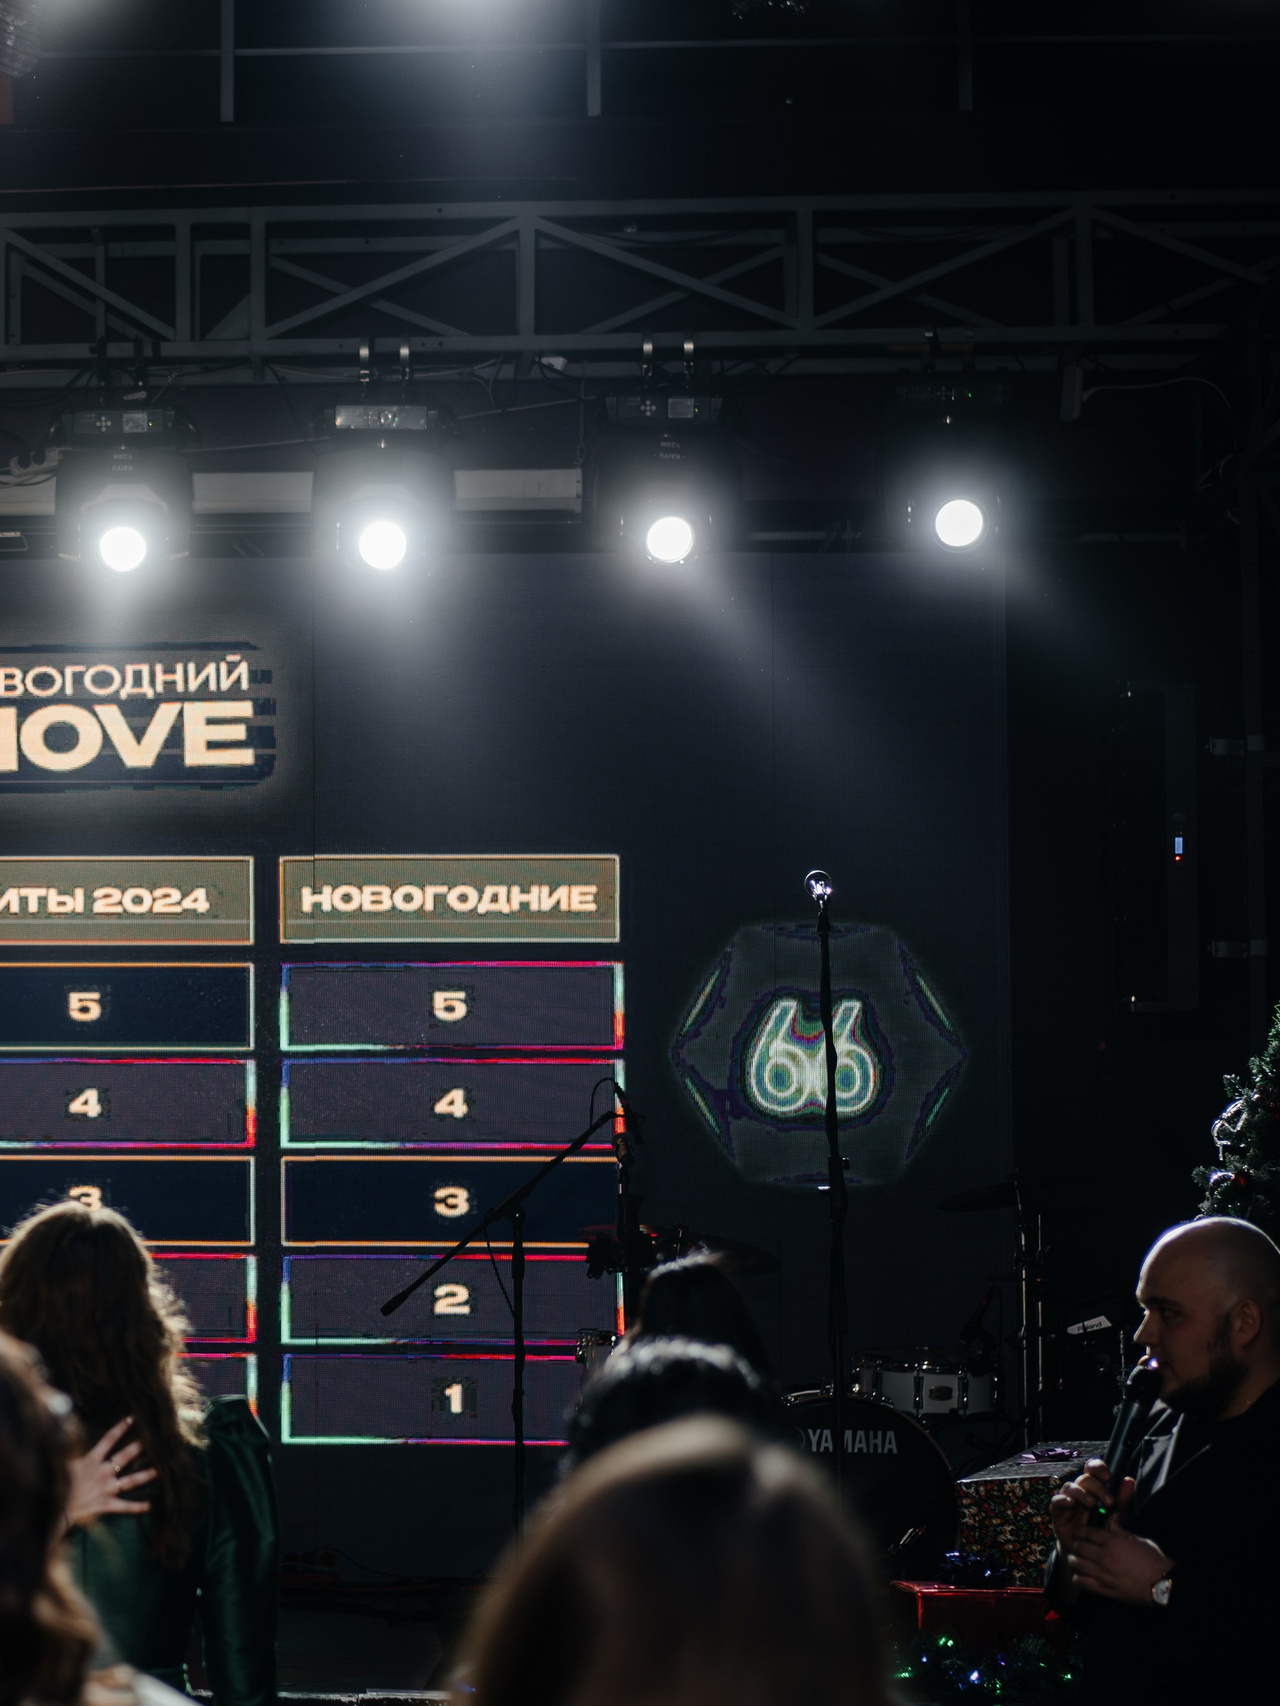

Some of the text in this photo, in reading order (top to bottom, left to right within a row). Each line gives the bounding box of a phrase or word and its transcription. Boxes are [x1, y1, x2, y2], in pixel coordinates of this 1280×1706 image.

[92, 886, 211, 915] 2024
[300, 885, 599, 916] НОВОГОДНИЕ
[68, 991, 102, 1023] 5
[433, 991, 469, 1022] 5
[750, 998, 877, 1113] 66
[68, 1087, 102, 1118] 4
[433, 1088, 469, 1118] 4
[68, 1185, 102, 1213] 3
[433, 1186, 470, 1218] 3
[433, 1284, 471, 1315] 2
[444, 1383, 463, 1415] 1
[807, 1428, 898, 1455] YAMAHA
